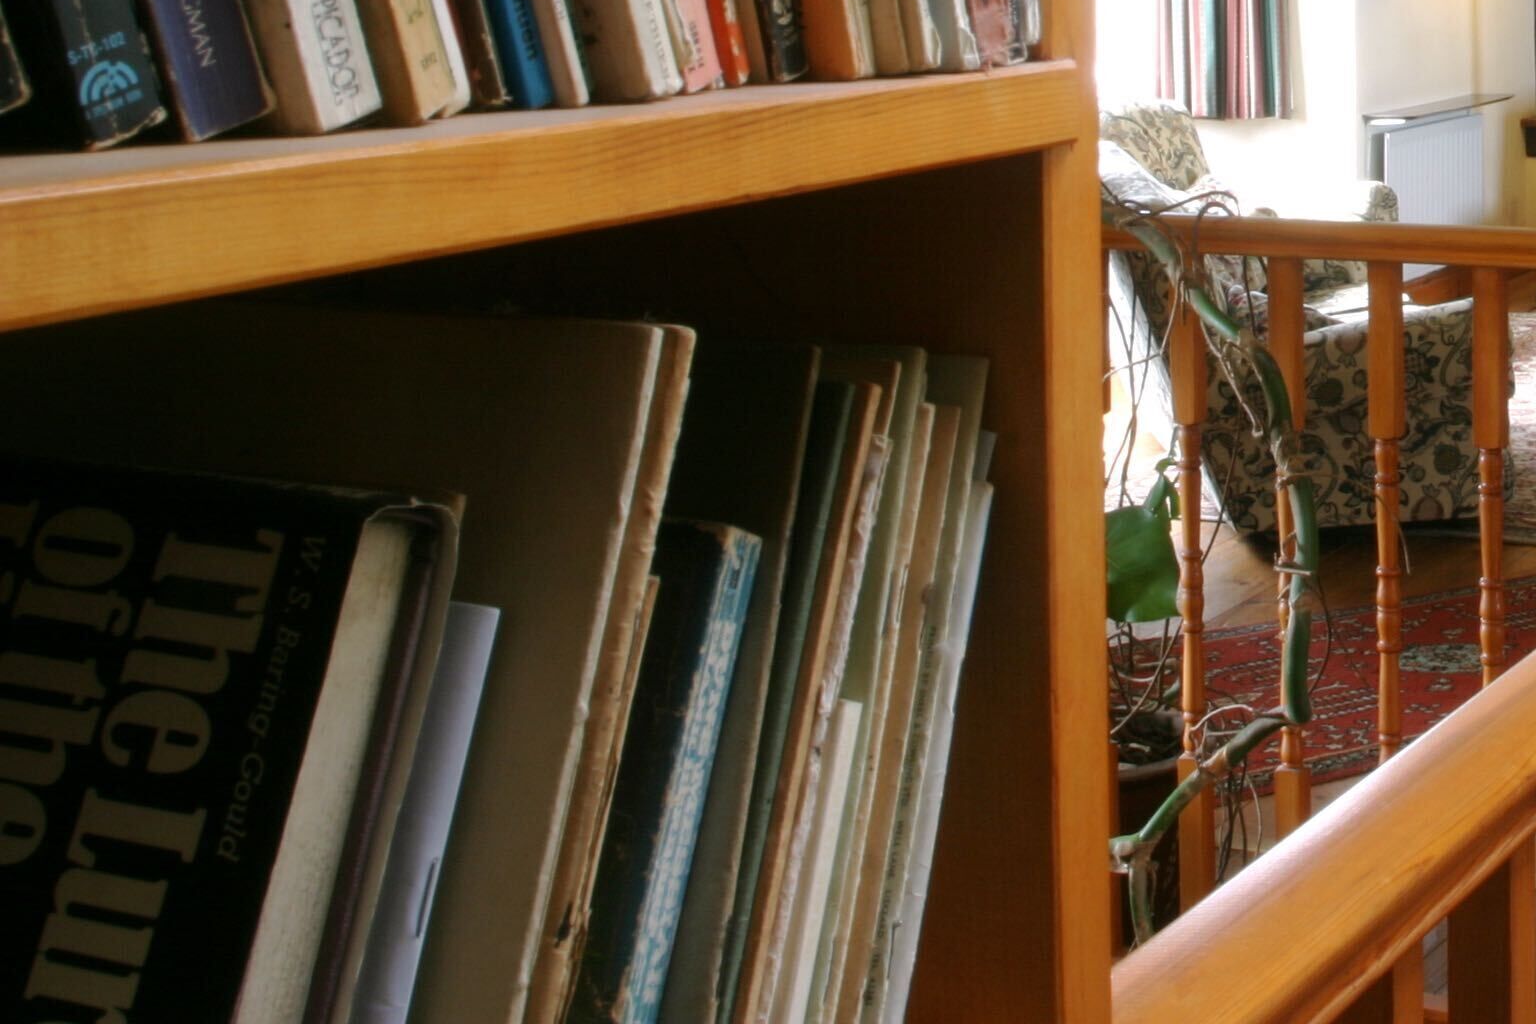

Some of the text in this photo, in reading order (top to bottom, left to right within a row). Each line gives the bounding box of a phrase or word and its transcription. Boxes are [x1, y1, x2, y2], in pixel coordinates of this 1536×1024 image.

[12, 507, 135, 637] of
[100, 527, 287, 775] The
[217, 533, 326, 864] W. S. Baring-Gould
